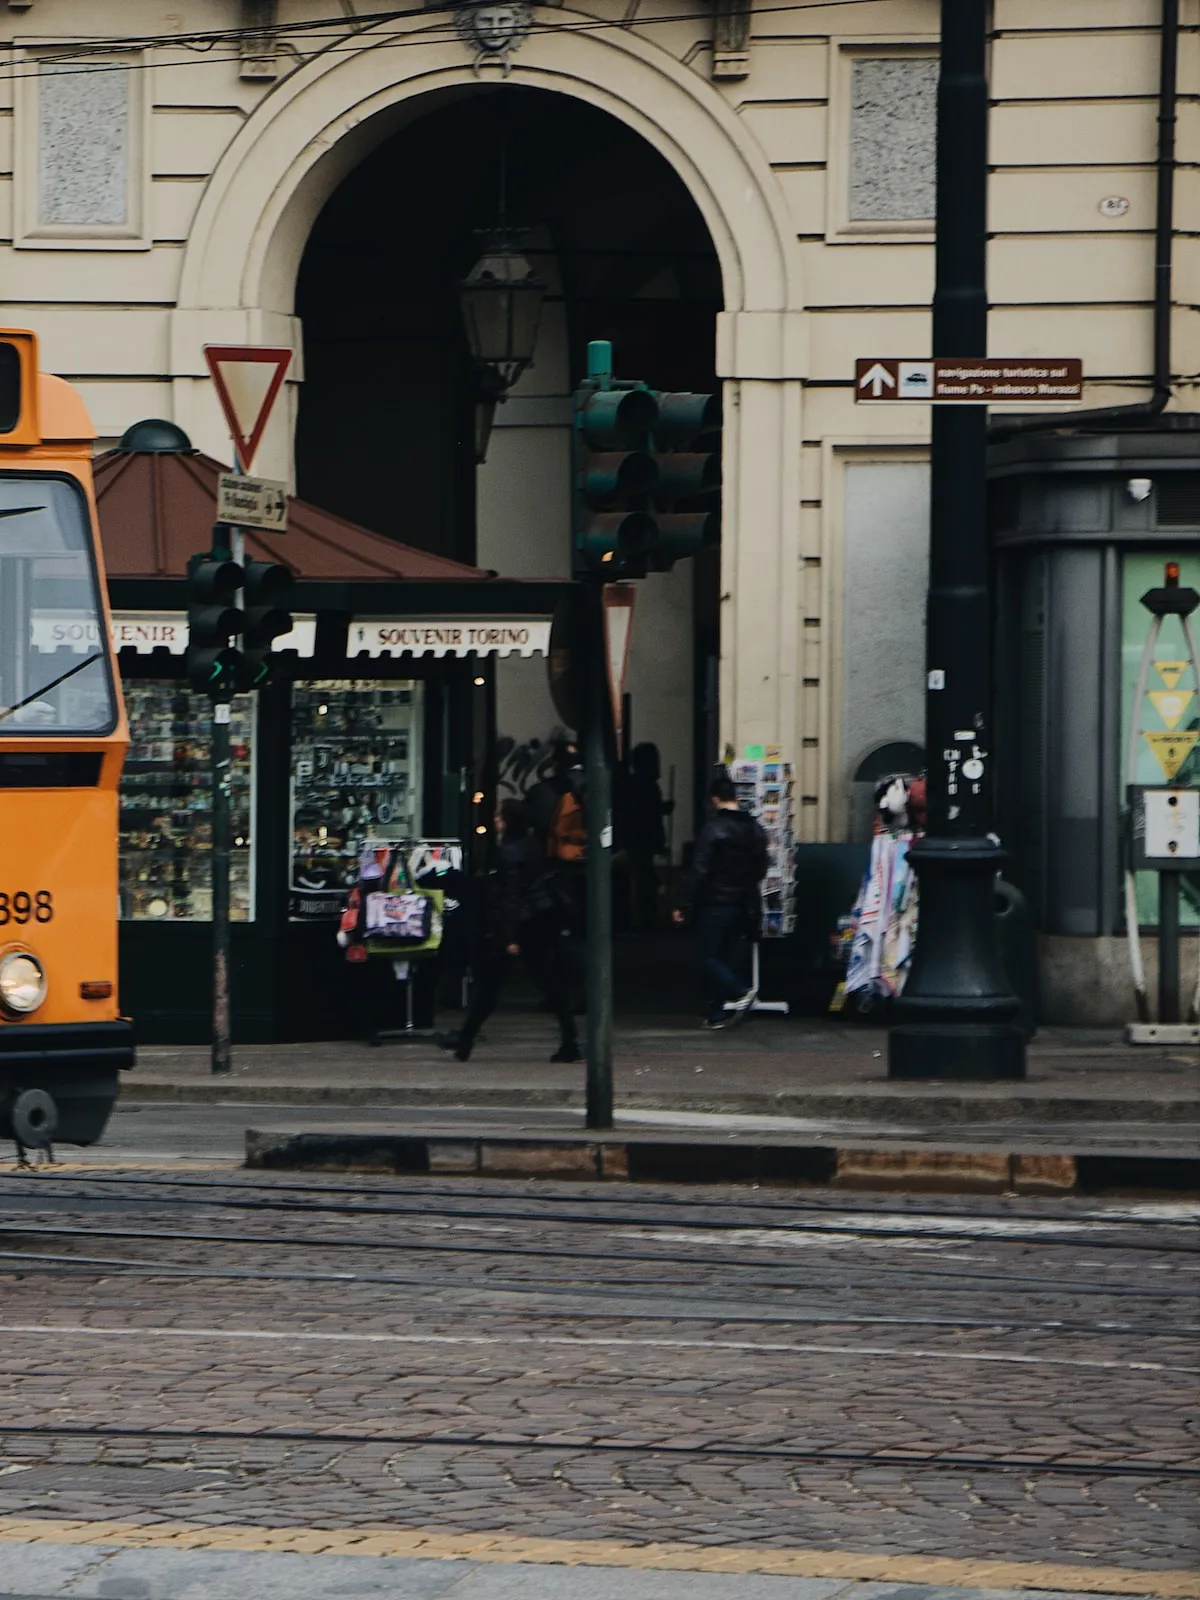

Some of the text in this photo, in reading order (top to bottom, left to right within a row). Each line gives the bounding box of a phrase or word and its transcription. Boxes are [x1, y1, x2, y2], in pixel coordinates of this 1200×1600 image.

[51, 624, 177, 641] SOUENIR
[378, 628, 530, 646] SOUVENIR TORINO
